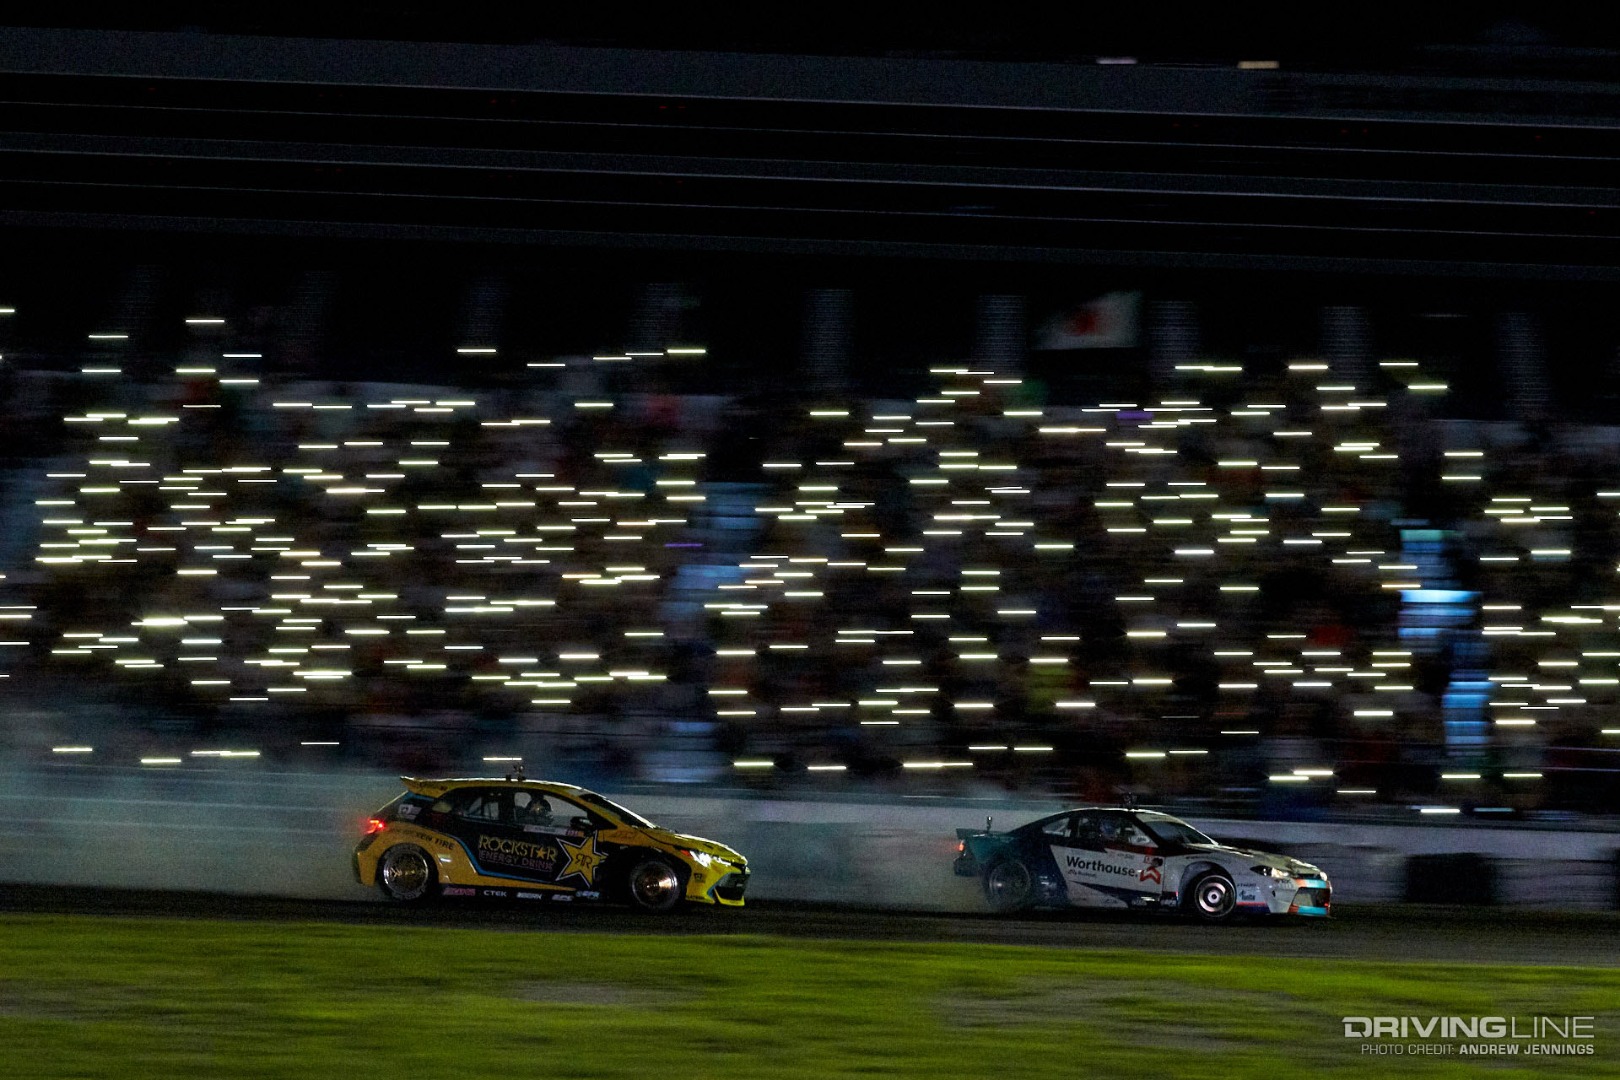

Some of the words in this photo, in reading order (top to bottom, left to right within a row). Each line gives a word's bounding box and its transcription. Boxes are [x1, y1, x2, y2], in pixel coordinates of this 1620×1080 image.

[435, 838, 455, 850] TIRE
[479, 849, 519, 864] ENERGY
[521, 857, 554, 870] DRINK
[483, 889, 508, 898] CTEK
